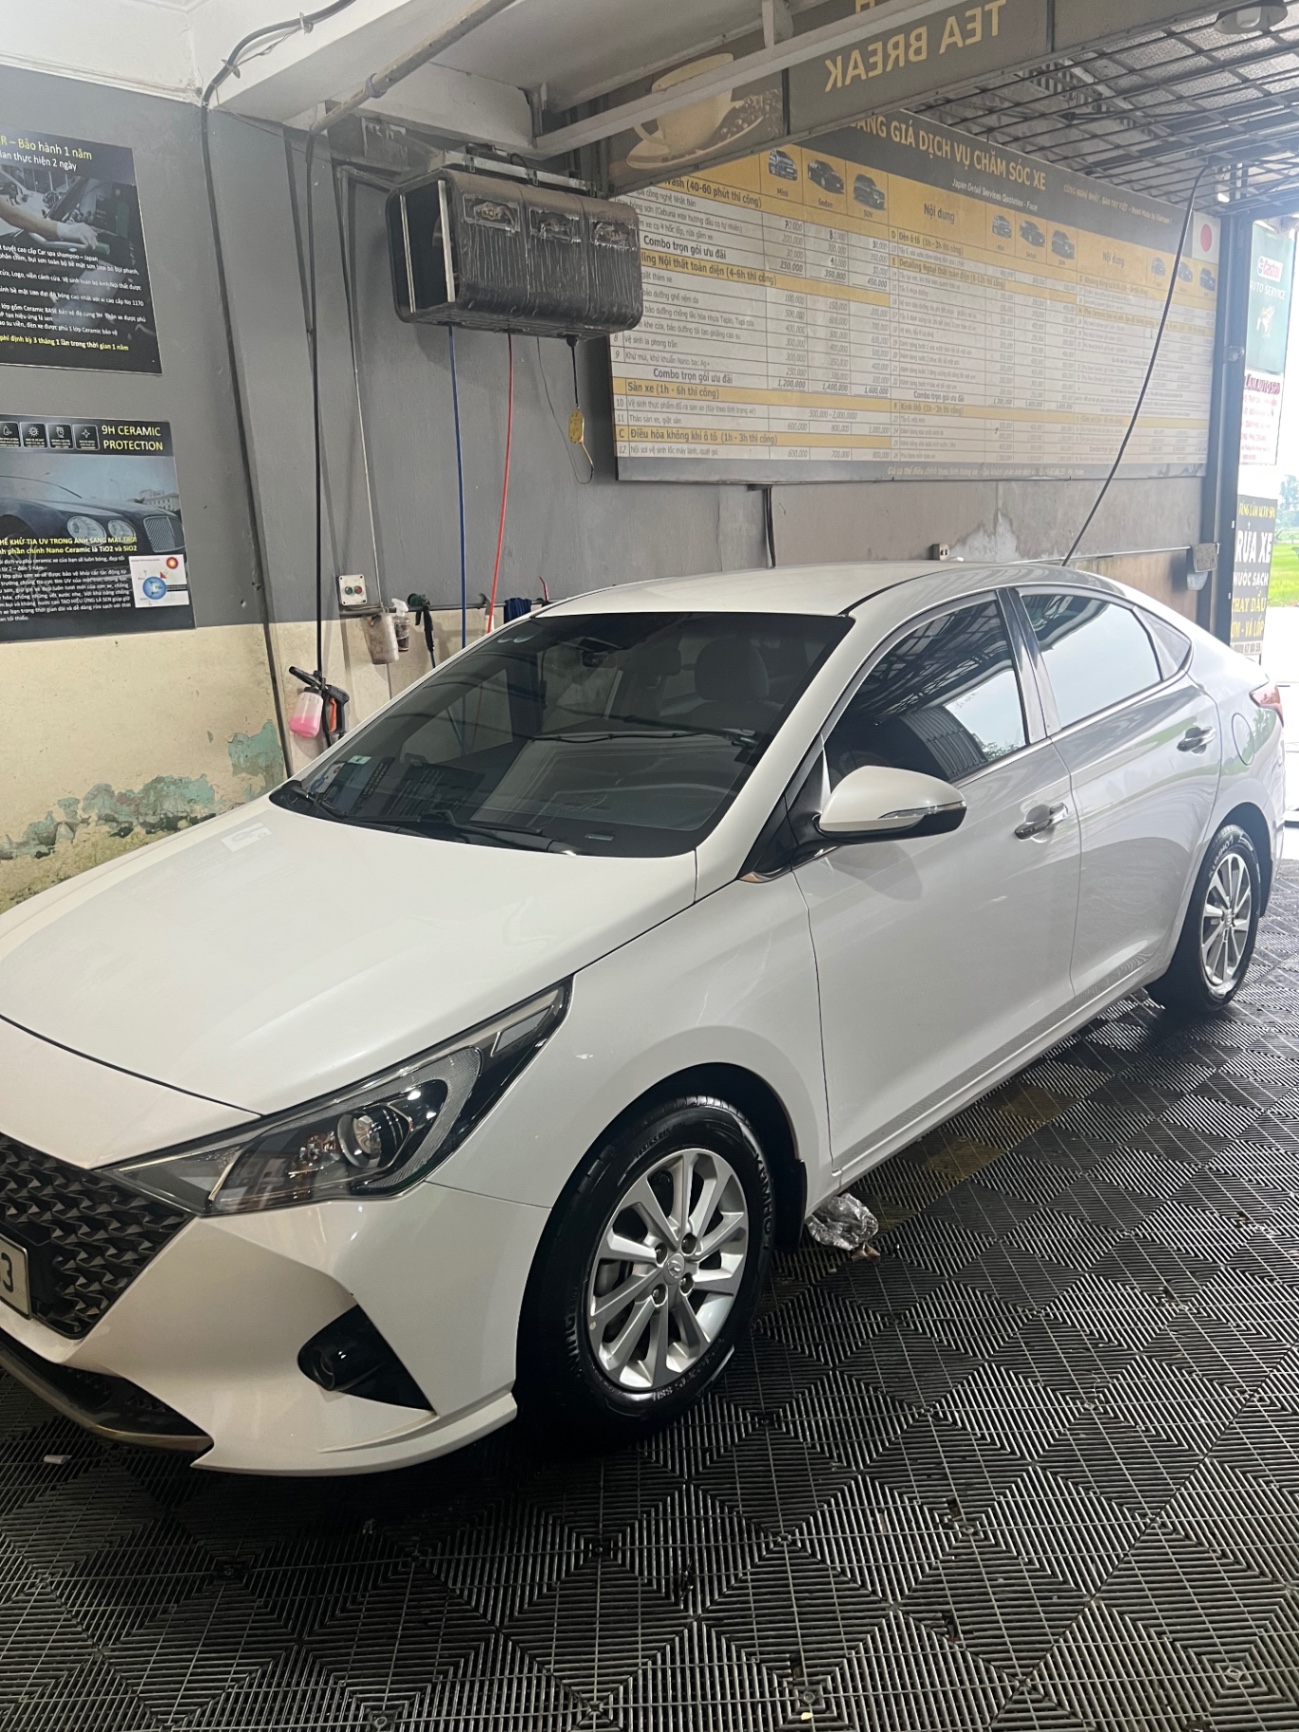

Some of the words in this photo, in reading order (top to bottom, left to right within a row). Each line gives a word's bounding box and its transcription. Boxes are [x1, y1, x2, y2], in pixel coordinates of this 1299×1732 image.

[18, 137, 36, 151] Bảo
[38, 141, 62, 155] hành
[64, 146, 70, 156] 1
[72, 148, 92, 160] năm
[890, 119, 916, 148] GIÁ
[919, 130, 950, 159] DỊCH
[954, 142, 971, 170] VỤ
[973, 149, 1006, 178] CHĂM
[1009, 160, 1031, 185] SÓC
[1033, 169, 1046, 190] XE
[14, 152, 32, 163] thực
[33, 155, 51, 166] hiện
[52, 158, 58, 167] 2
[60, 159, 77, 172] ngày
[686, 179, 712, 195] (40-60
[713, 187, 730, 199] phút
[731, 191, 741, 202] thi
[742, 194, 762, 208] công)
[952, 178, 967, 190] Japan
[967, 182, 982, 195] Detail
[923, 203, 936, 221] Nội
[937, 207, 955, 225] dung
[643, 235, 671, 250] Combo
[672, 241, 689, 256] trọn
[690, 244, 702, 257] gói
[703, 247, 714, 257] ưu
[715, 248, 727, 260] đãi
[658, 255, 672, 267] Nội
[674, 258, 689, 270] thất
[691, 262, 708, 273] toàn
[709, 265, 724, 277] diện
[726, 266, 746, 280] (4-6h
[747, 269, 757, 281] thi
[758, 271, 777, 287] công)
[899, 258, 922, 272] Detailing
[653, 368, 680, 380] Combo
[681, 371, 697, 384] trọn
[698, 372, 710, 385] gói
[711, 375, 722, 383] ưu
[722, 374, 733, 385] đãi
[628, 381, 643, 393] Sàn
[644, 384, 655, 393] xe
[656, 384, 669, 397] (1h
[677, 385, 686, 395] 6h
[687, 386, 698, 396] thi
[699, 388, 720, 400] công)
[101, 424, 116, 435] 9H
[117, 425, 162, 437] CERAMIC
[618, 428, 625, 438] C
[630, 428, 648, 439] Điều
[650, 428, 665, 440] hòa
[666, 430, 690, 442] không
[691, 430, 702, 441] khí
[710, 432, 718, 442] tô
[721, 432, 733, 443] (1h
[739, 433, 748, 442] 3h
[749, 432, 758, 442] thi
[759, 434, 778, 445] công)
[103, 440, 164, 451] PROTECTION
[50, 537, 73, 545] TRONG
[64, 546, 91, 554] Ceramic
[91, 545, 98, 553] là
[1235, 521, 1257, 564] RỬA
[1258, 531, 1274, 564] XE
[1252, 571, 1270, 589] SẠCH
[1, 1251, 14, 1293] 3
